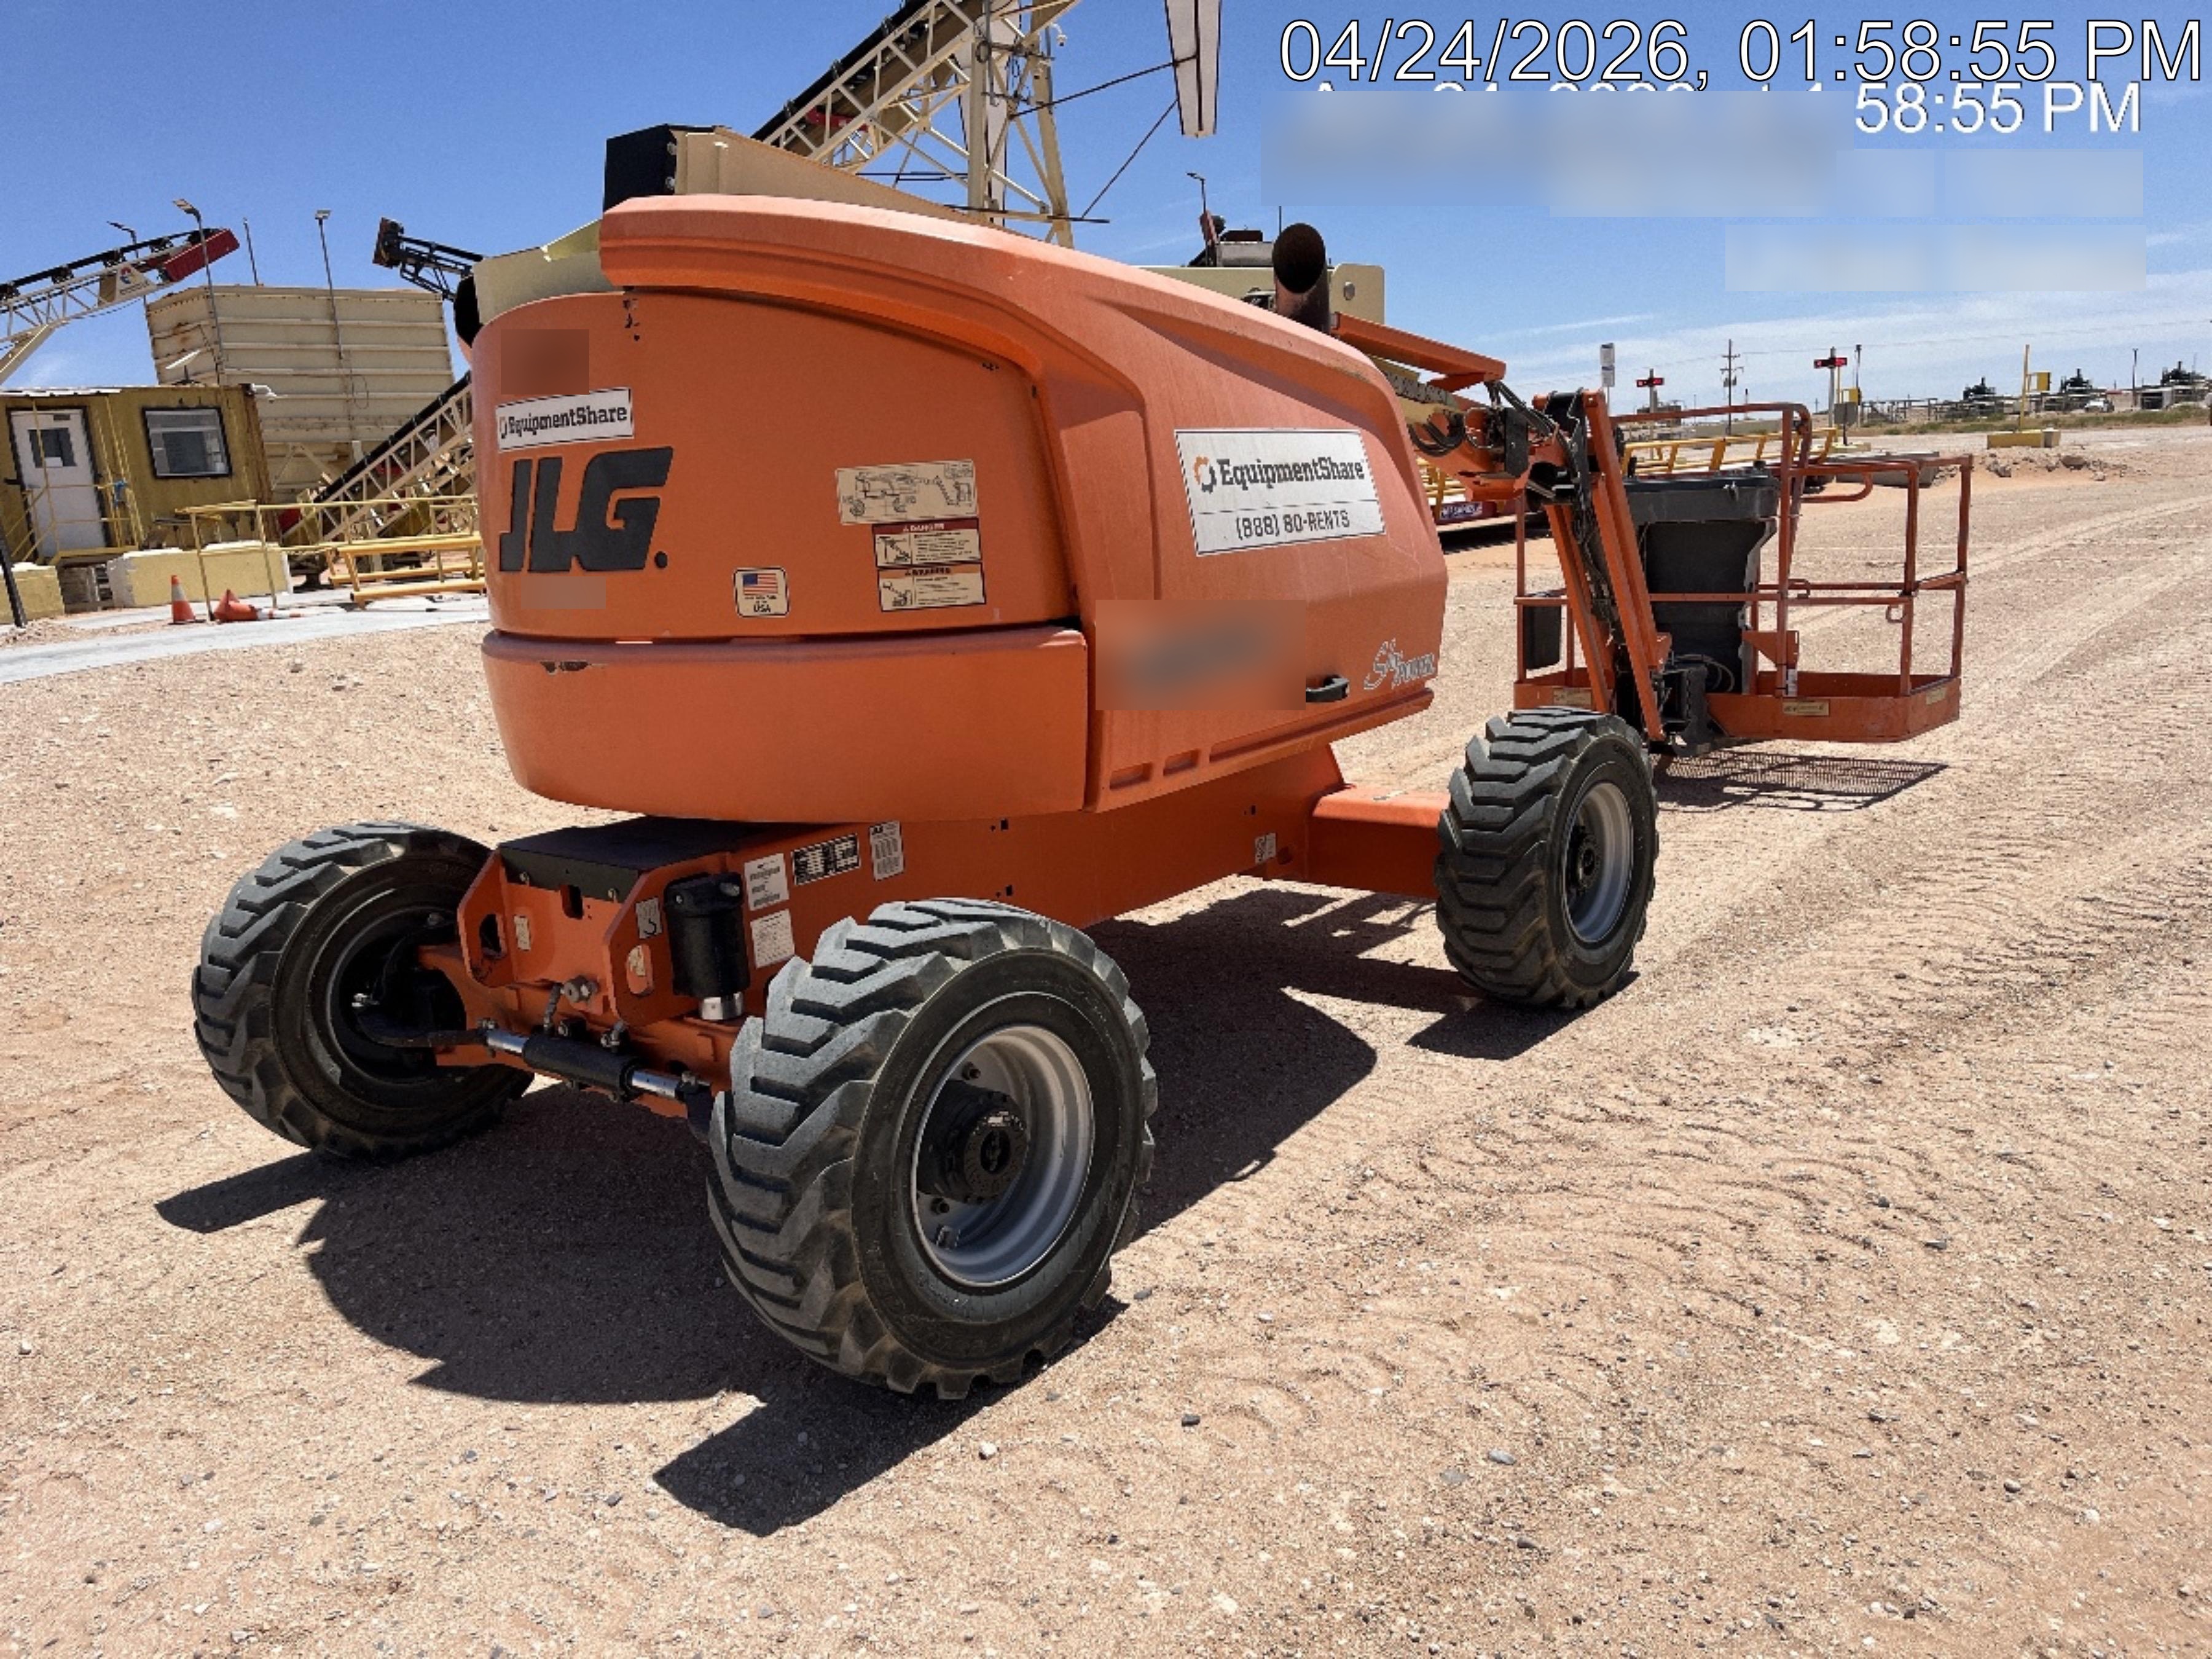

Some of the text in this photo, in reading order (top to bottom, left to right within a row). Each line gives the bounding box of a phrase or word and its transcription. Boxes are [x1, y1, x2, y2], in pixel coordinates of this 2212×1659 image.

[508, 405, 627, 436] EquipmentShare
[1217, 456, 1365, 490] EquipmentShare
[1236, 510, 1350, 540] (888) 80-RENTS
